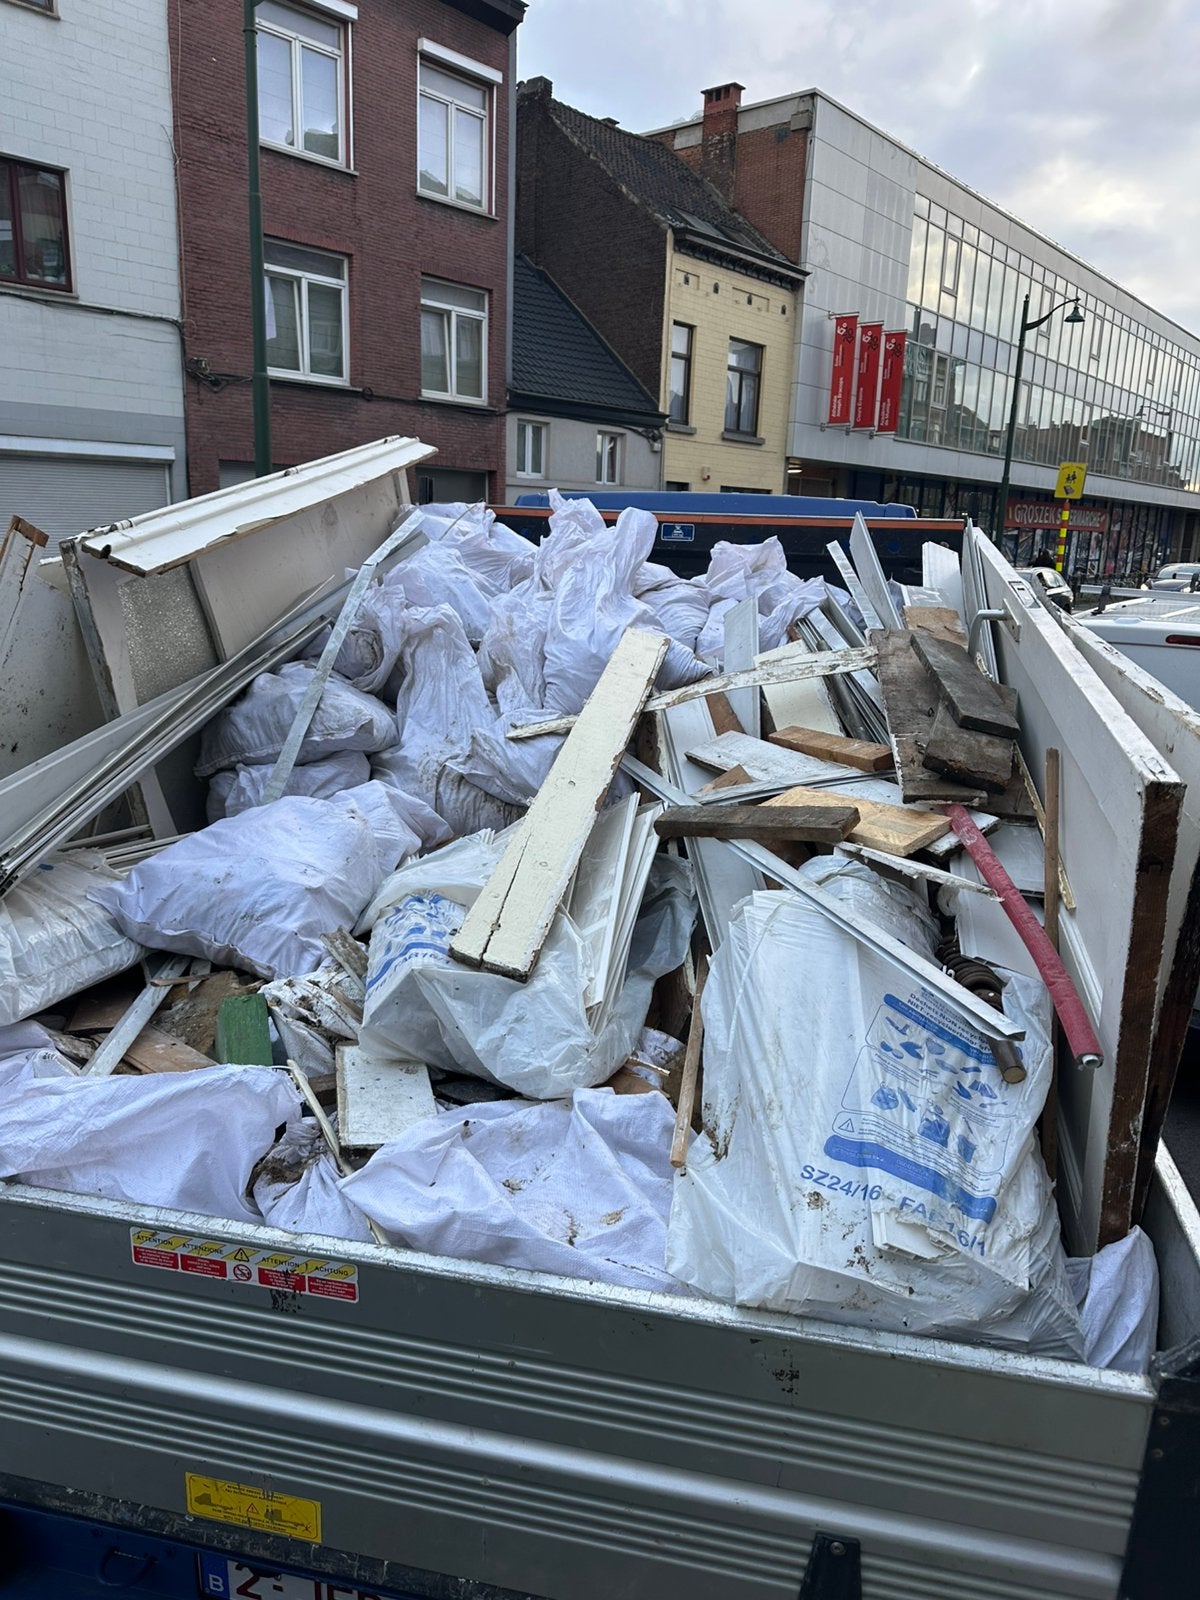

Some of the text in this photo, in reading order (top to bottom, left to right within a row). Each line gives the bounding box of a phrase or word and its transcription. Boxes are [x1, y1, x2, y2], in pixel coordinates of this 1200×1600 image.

[1014, 504, 1056, 525] GROSZEK
[938, 1012, 958, 1028] NON
[800, 1164, 883, 1201] SZ24/16
[136, 1233, 349, 1277] ATTENTION ATTENZIONE ATTENTION ACHTUNG
[208, 1573, 225, 1592] B
